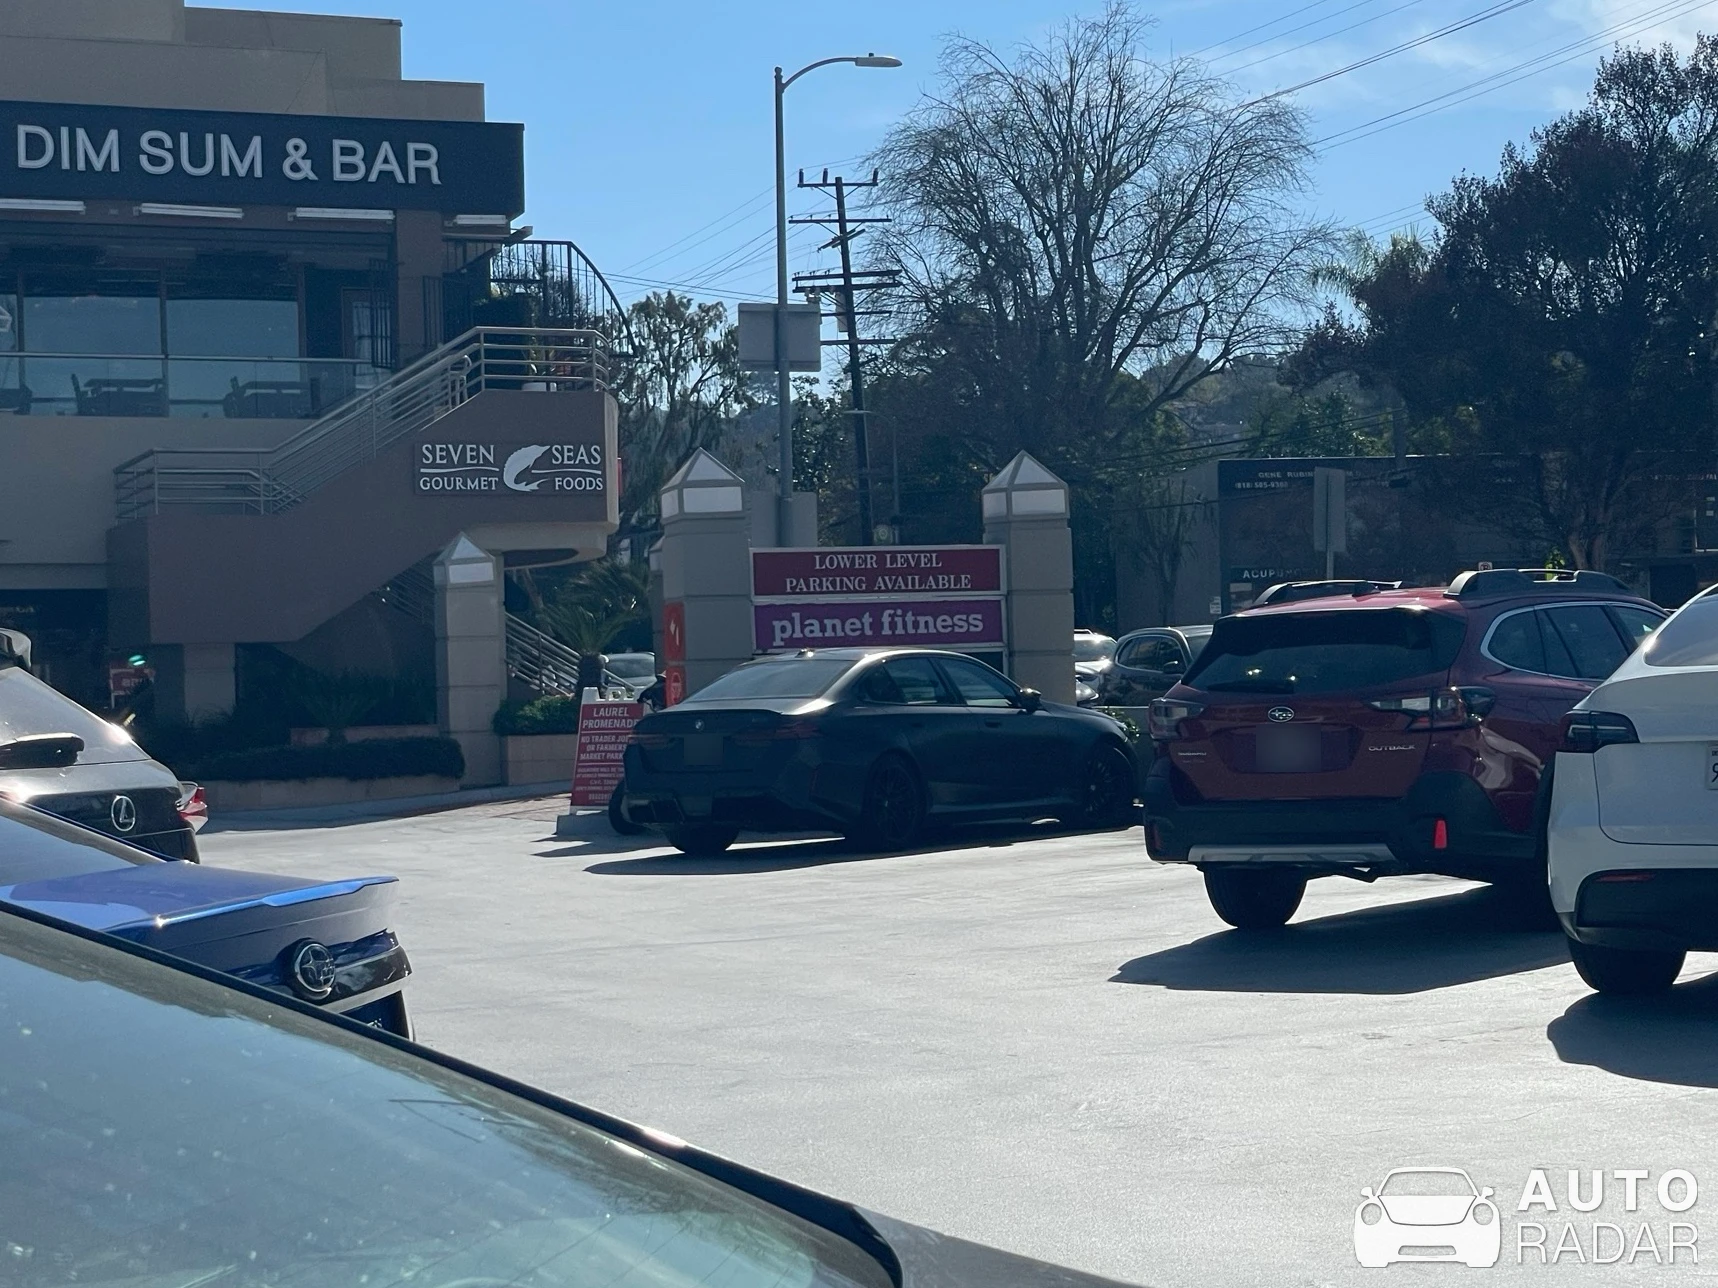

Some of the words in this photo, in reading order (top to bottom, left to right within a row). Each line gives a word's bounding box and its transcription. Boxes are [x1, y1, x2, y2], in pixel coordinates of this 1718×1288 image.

[17, 124, 120, 173] DIM
[138, 130, 263, 178] SUM
[281, 137, 318, 181] &
[332, 139, 441, 185] BAR
[421, 444, 495, 464] SEVEN
[551, 445, 601, 465] SEAS
[420, 477, 499, 490] GOURMET
[555, 477, 603, 490] FOODS
[815, 555, 878, 570] LOWER
[885, 553, 942, 568] LEVEL
[786, 577, 867, 592] PARKING
[874, 575, 971, 590] AVAILABLE
[772, 611, 873, 646] planet
[881, 609, 983, 635] fitness
[593, 707, 629, 717] LAUREL
[580, 752, 605, 760] MARKET
